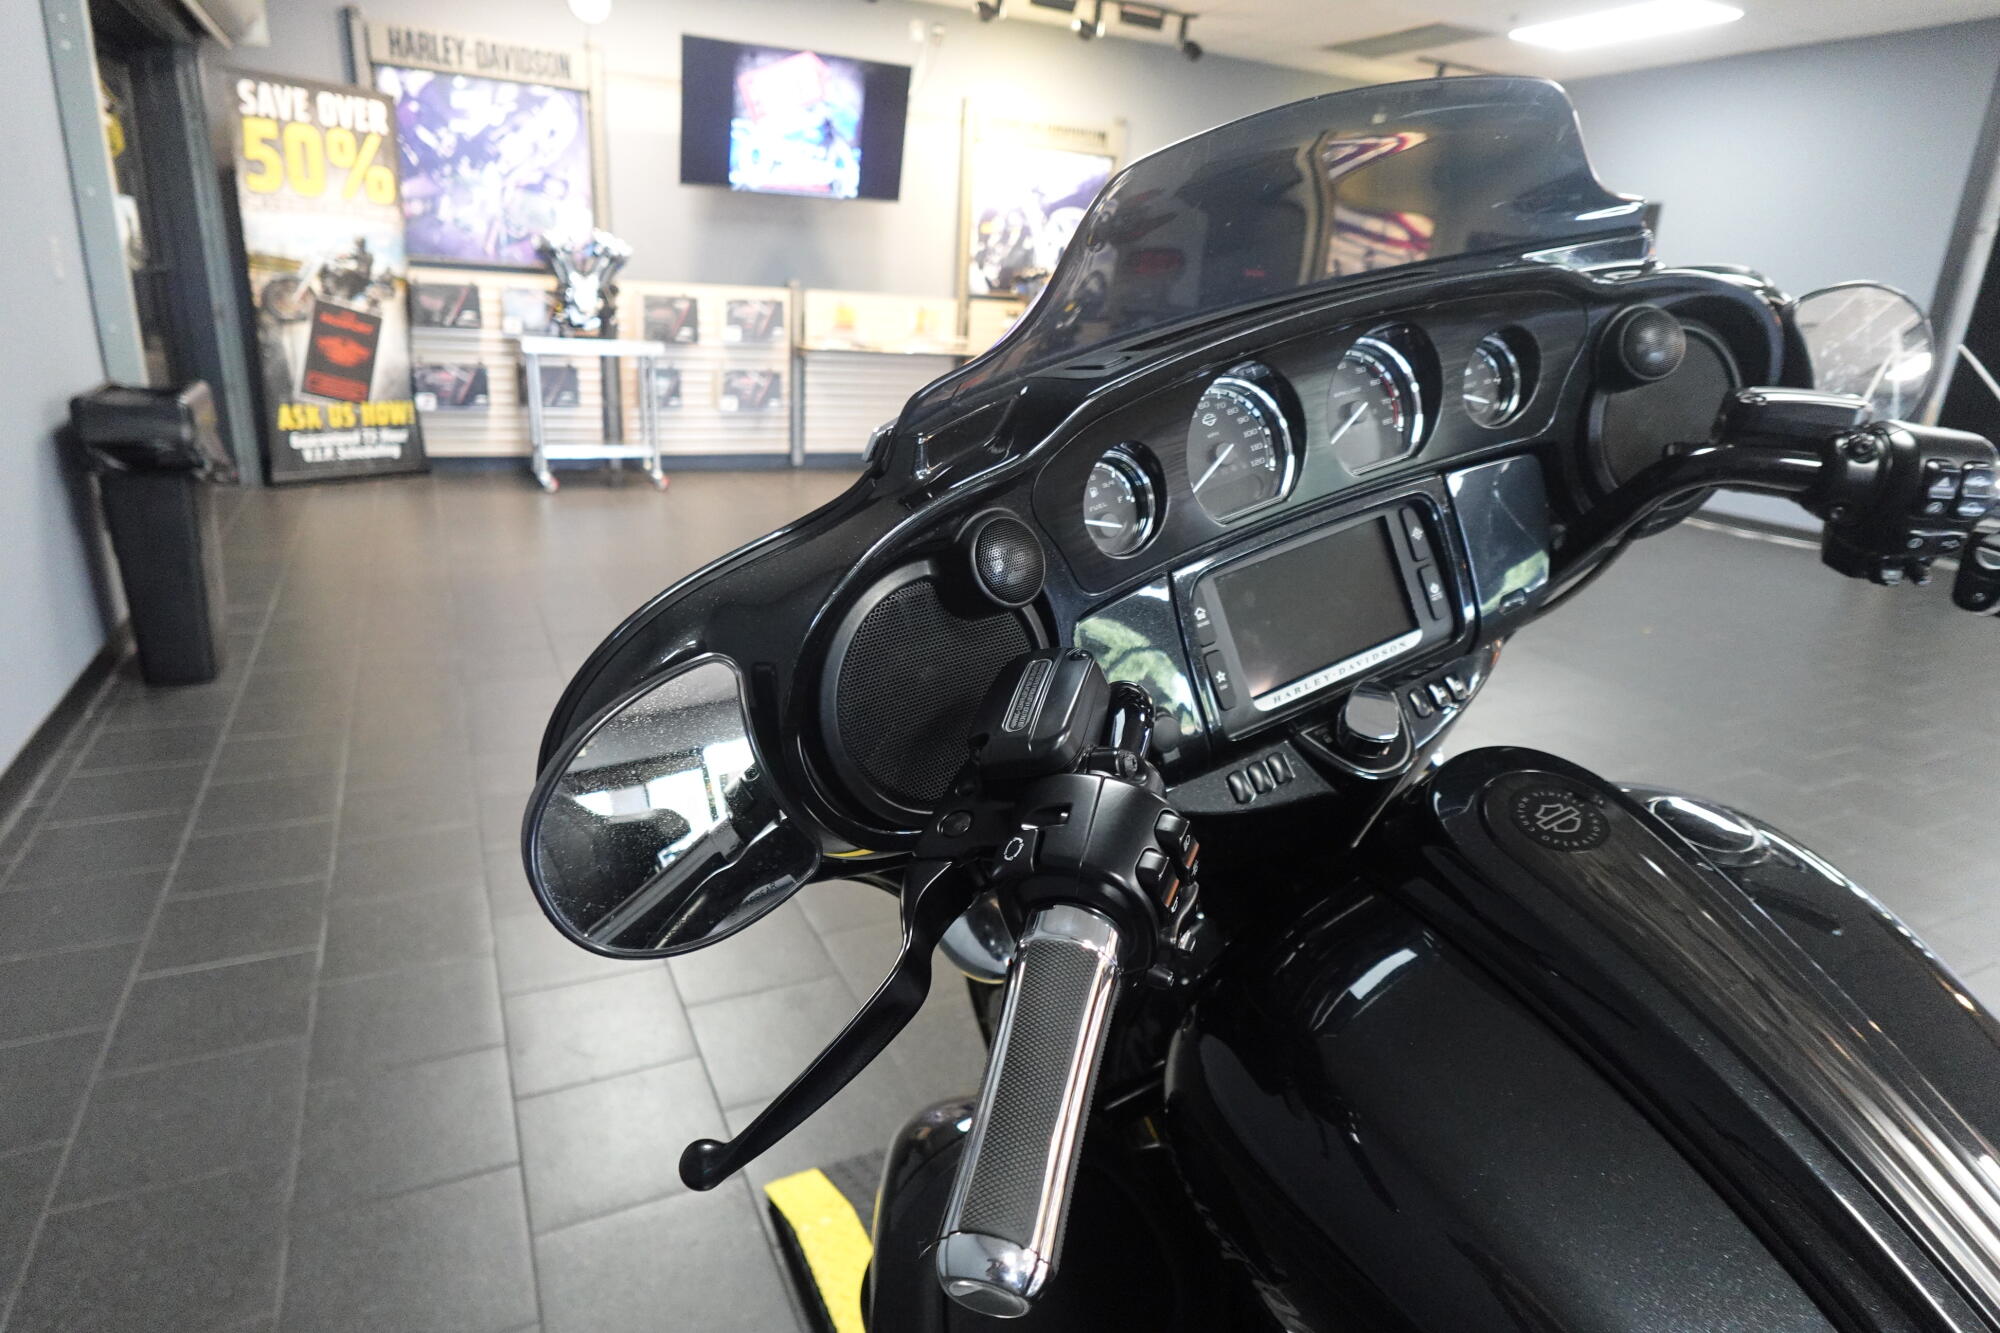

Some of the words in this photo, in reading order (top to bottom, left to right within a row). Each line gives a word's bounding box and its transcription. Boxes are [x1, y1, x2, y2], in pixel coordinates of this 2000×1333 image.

[388, 27, 571, 80] HARLEY-DAVIDSON
[236, 78, 312, 122] SAVE
[316, 90, 390, 136] OVER
[242, 116, 396, 205] 50%
[278, 403, 323, 431] ASK
[327, 401, 357, 428] US
[360, 400, 416, 427] NOW!
[1273, 641, 1407, 705] HARLEY-DAVIDSON
